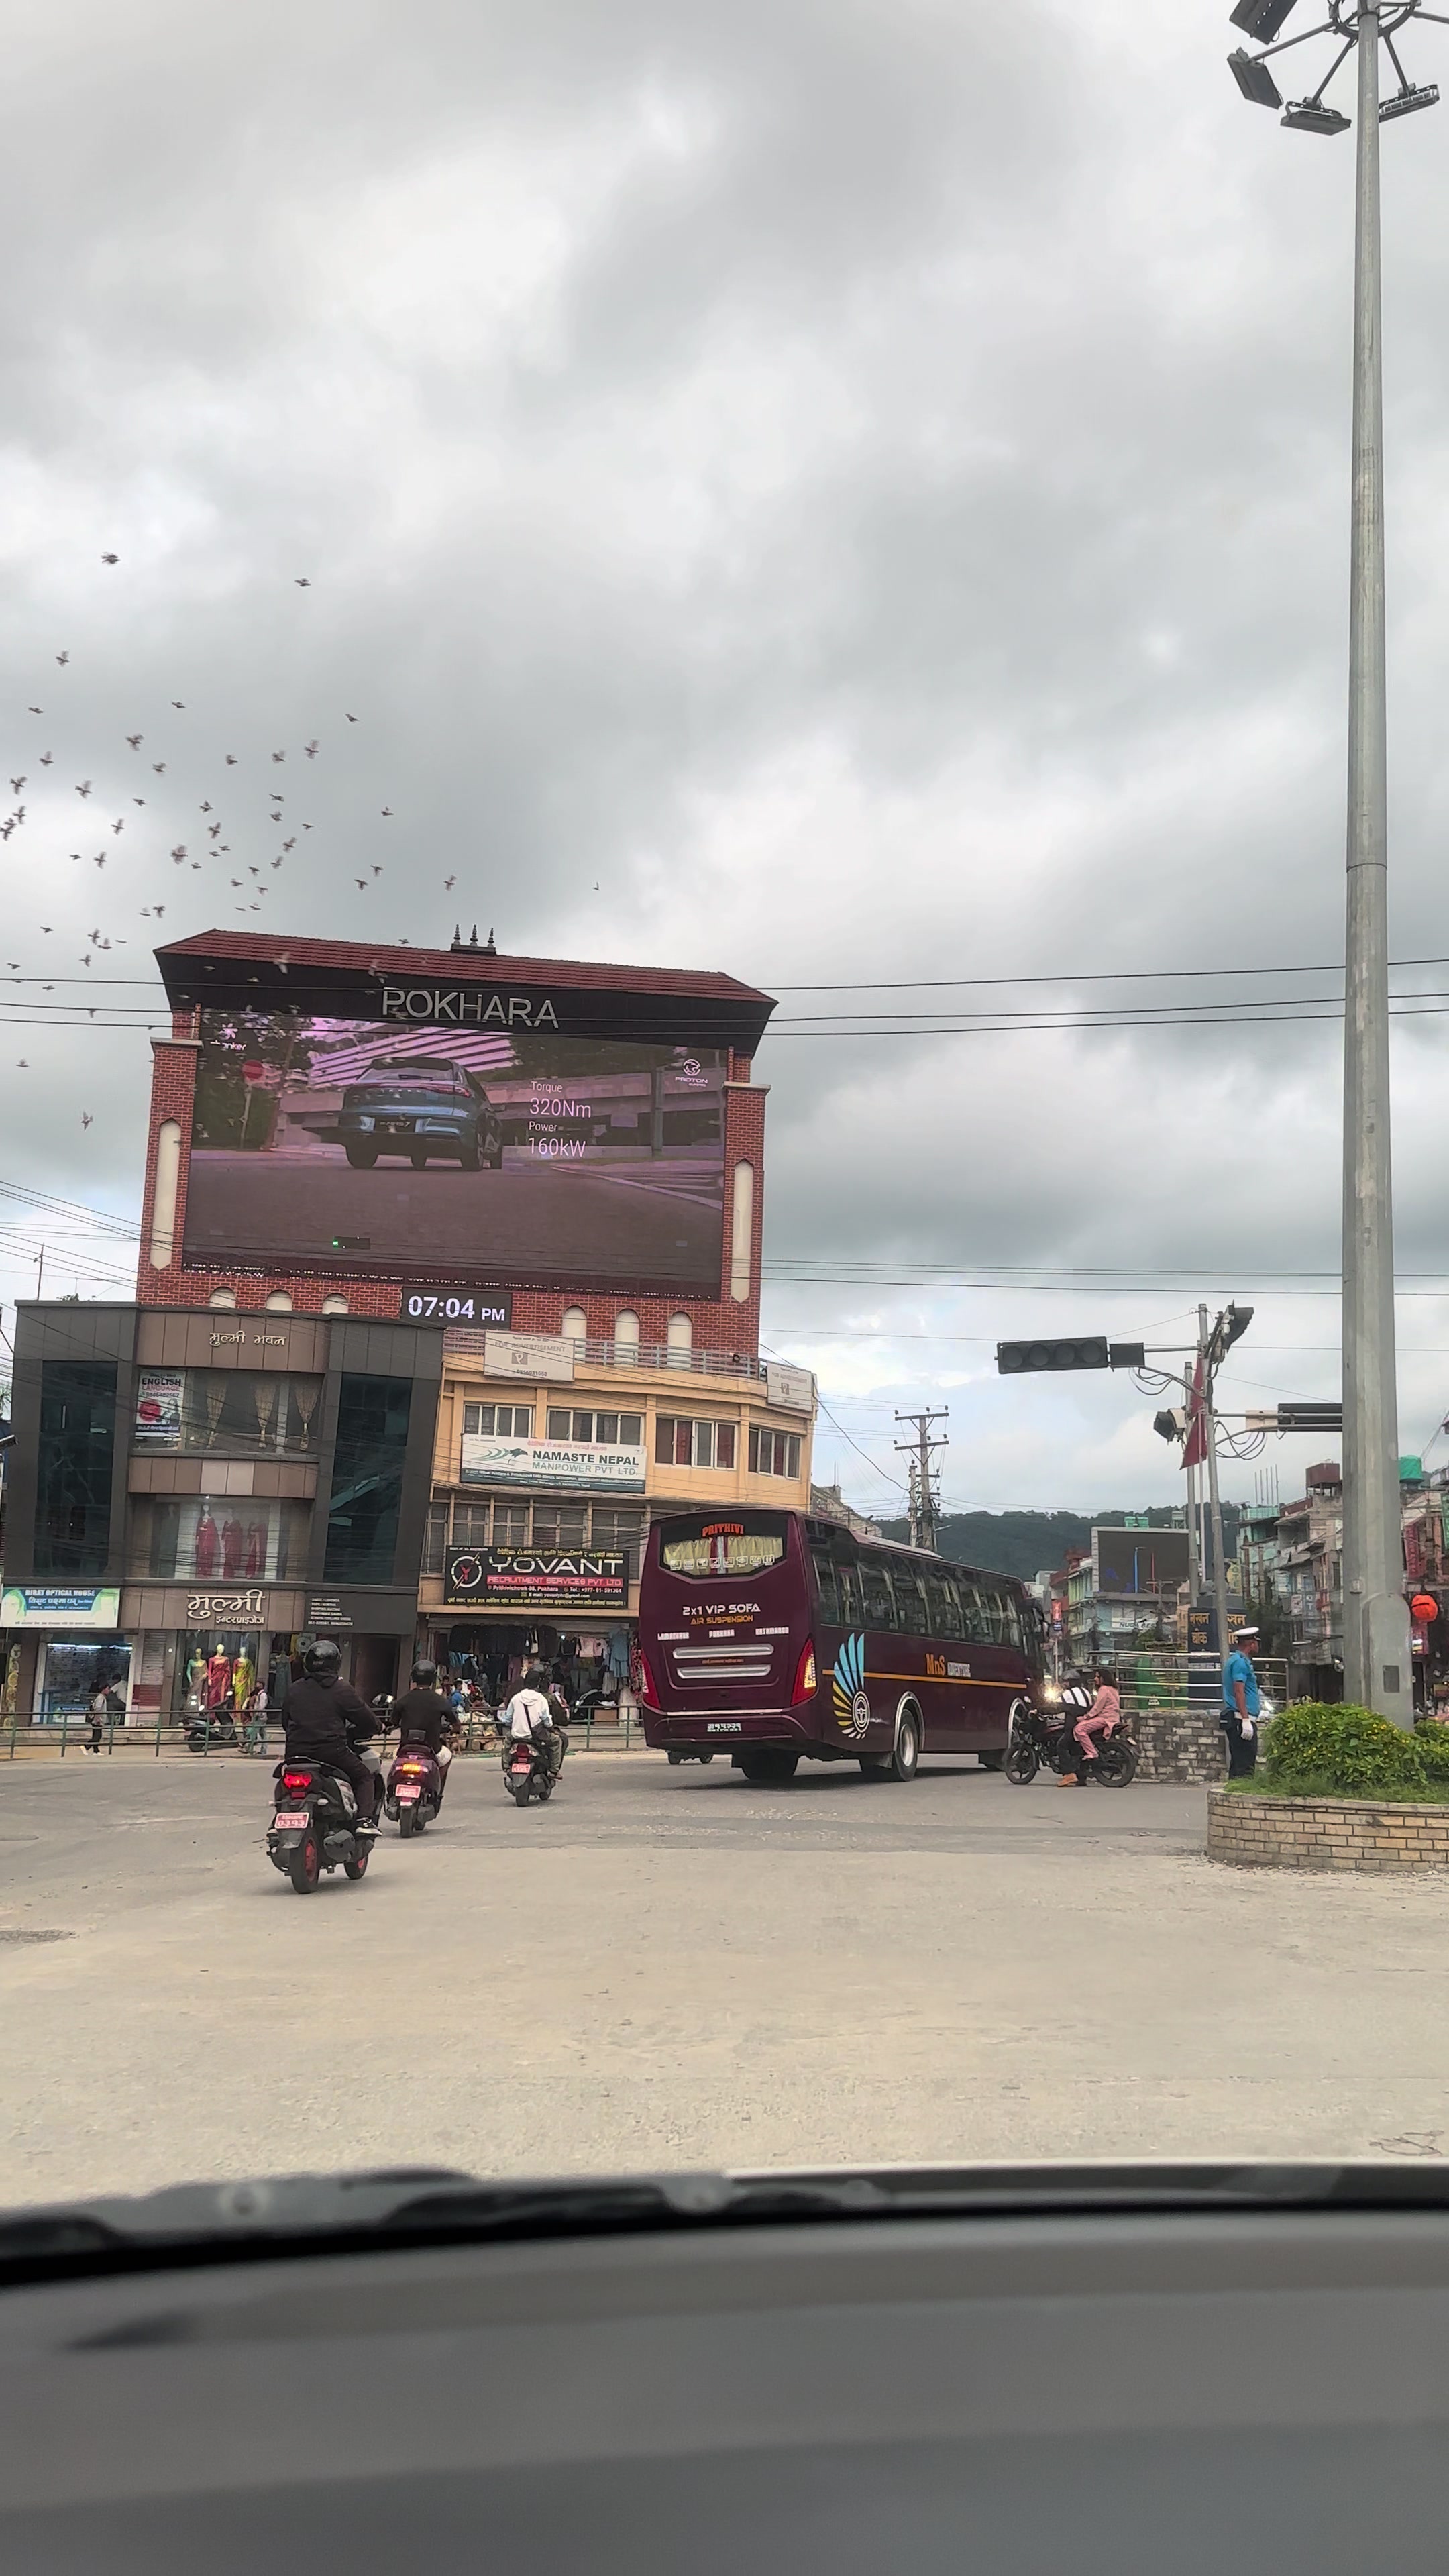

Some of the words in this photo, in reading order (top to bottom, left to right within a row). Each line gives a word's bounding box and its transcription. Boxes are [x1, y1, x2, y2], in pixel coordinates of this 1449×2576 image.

[382, 987, 559, 1028] POKHARA
[531, 1081, 563, 1094] Torque
[529, 1097, 591, 1118] 320Nm
[529, 1120, 558, 1132] Power
[528, 1137, 586, 1157] 160kW
[408, 1295, 475, 1319] 07:04
[481, 1307, 506, 1321] PM
[142, 1377, 181, 1387] ENGLISH
[533, 1450, 595, 1463] NAMASTE
[599, 1455, 639, 1466] NEPAL
[532, 1462, 592, 1473] MANPOWER
[618, 1468, 638, 1476] LTD.
[702, 1523, 744, 1537] PRITHIVI
[488, 1556, 623, 1575] YOVANT
[682, 1605, 702, 1615] 2x1
[705, 1605, 726, 1615] VIP
[728, 1603, 761, 1613] SOFA
[690, 1617, 704, 1625] AIR
[706, 1615, 754, 1624] SUSPENSION
